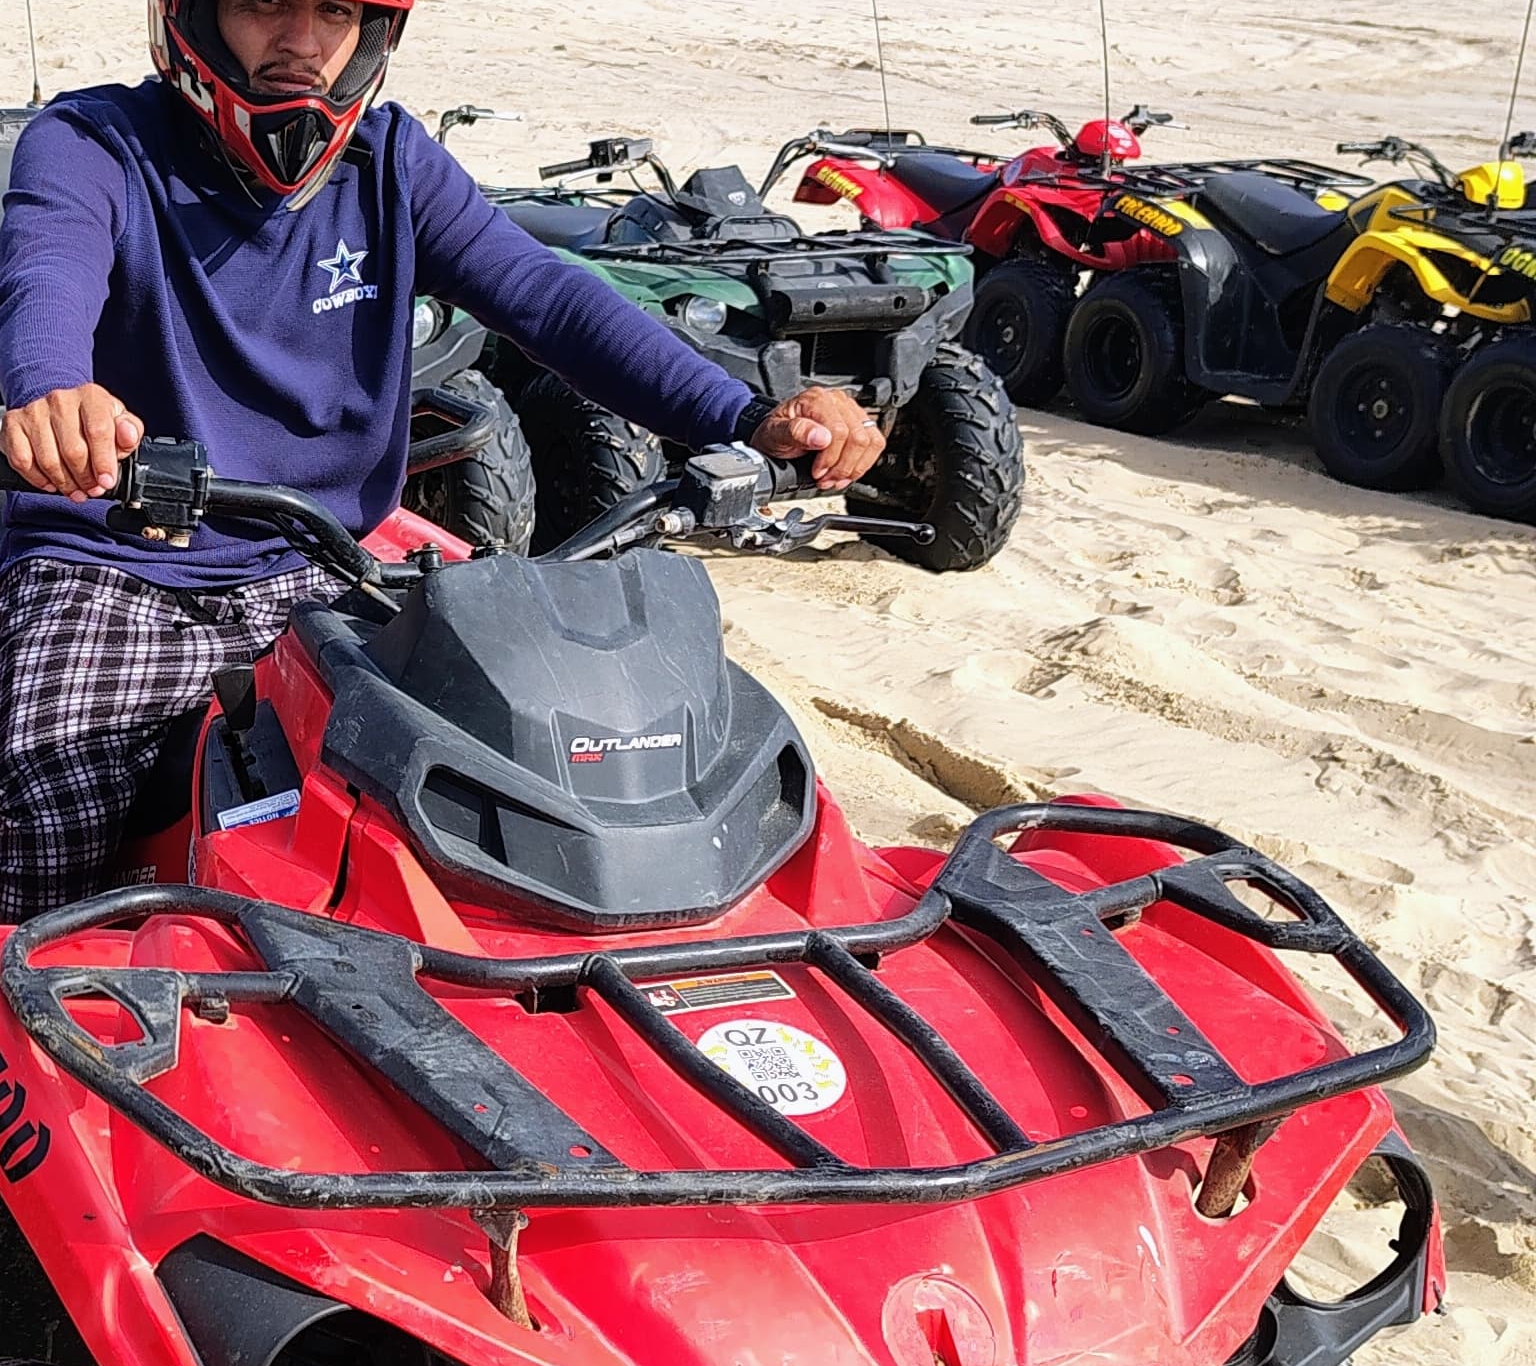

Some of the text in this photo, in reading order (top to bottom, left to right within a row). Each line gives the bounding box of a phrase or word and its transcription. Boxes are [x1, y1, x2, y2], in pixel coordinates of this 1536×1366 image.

[570, 734, 682, 753] OUTLANDER
[724, 1027, 777, 1047] QZ
[757, 1081, 819, 1105] 003
